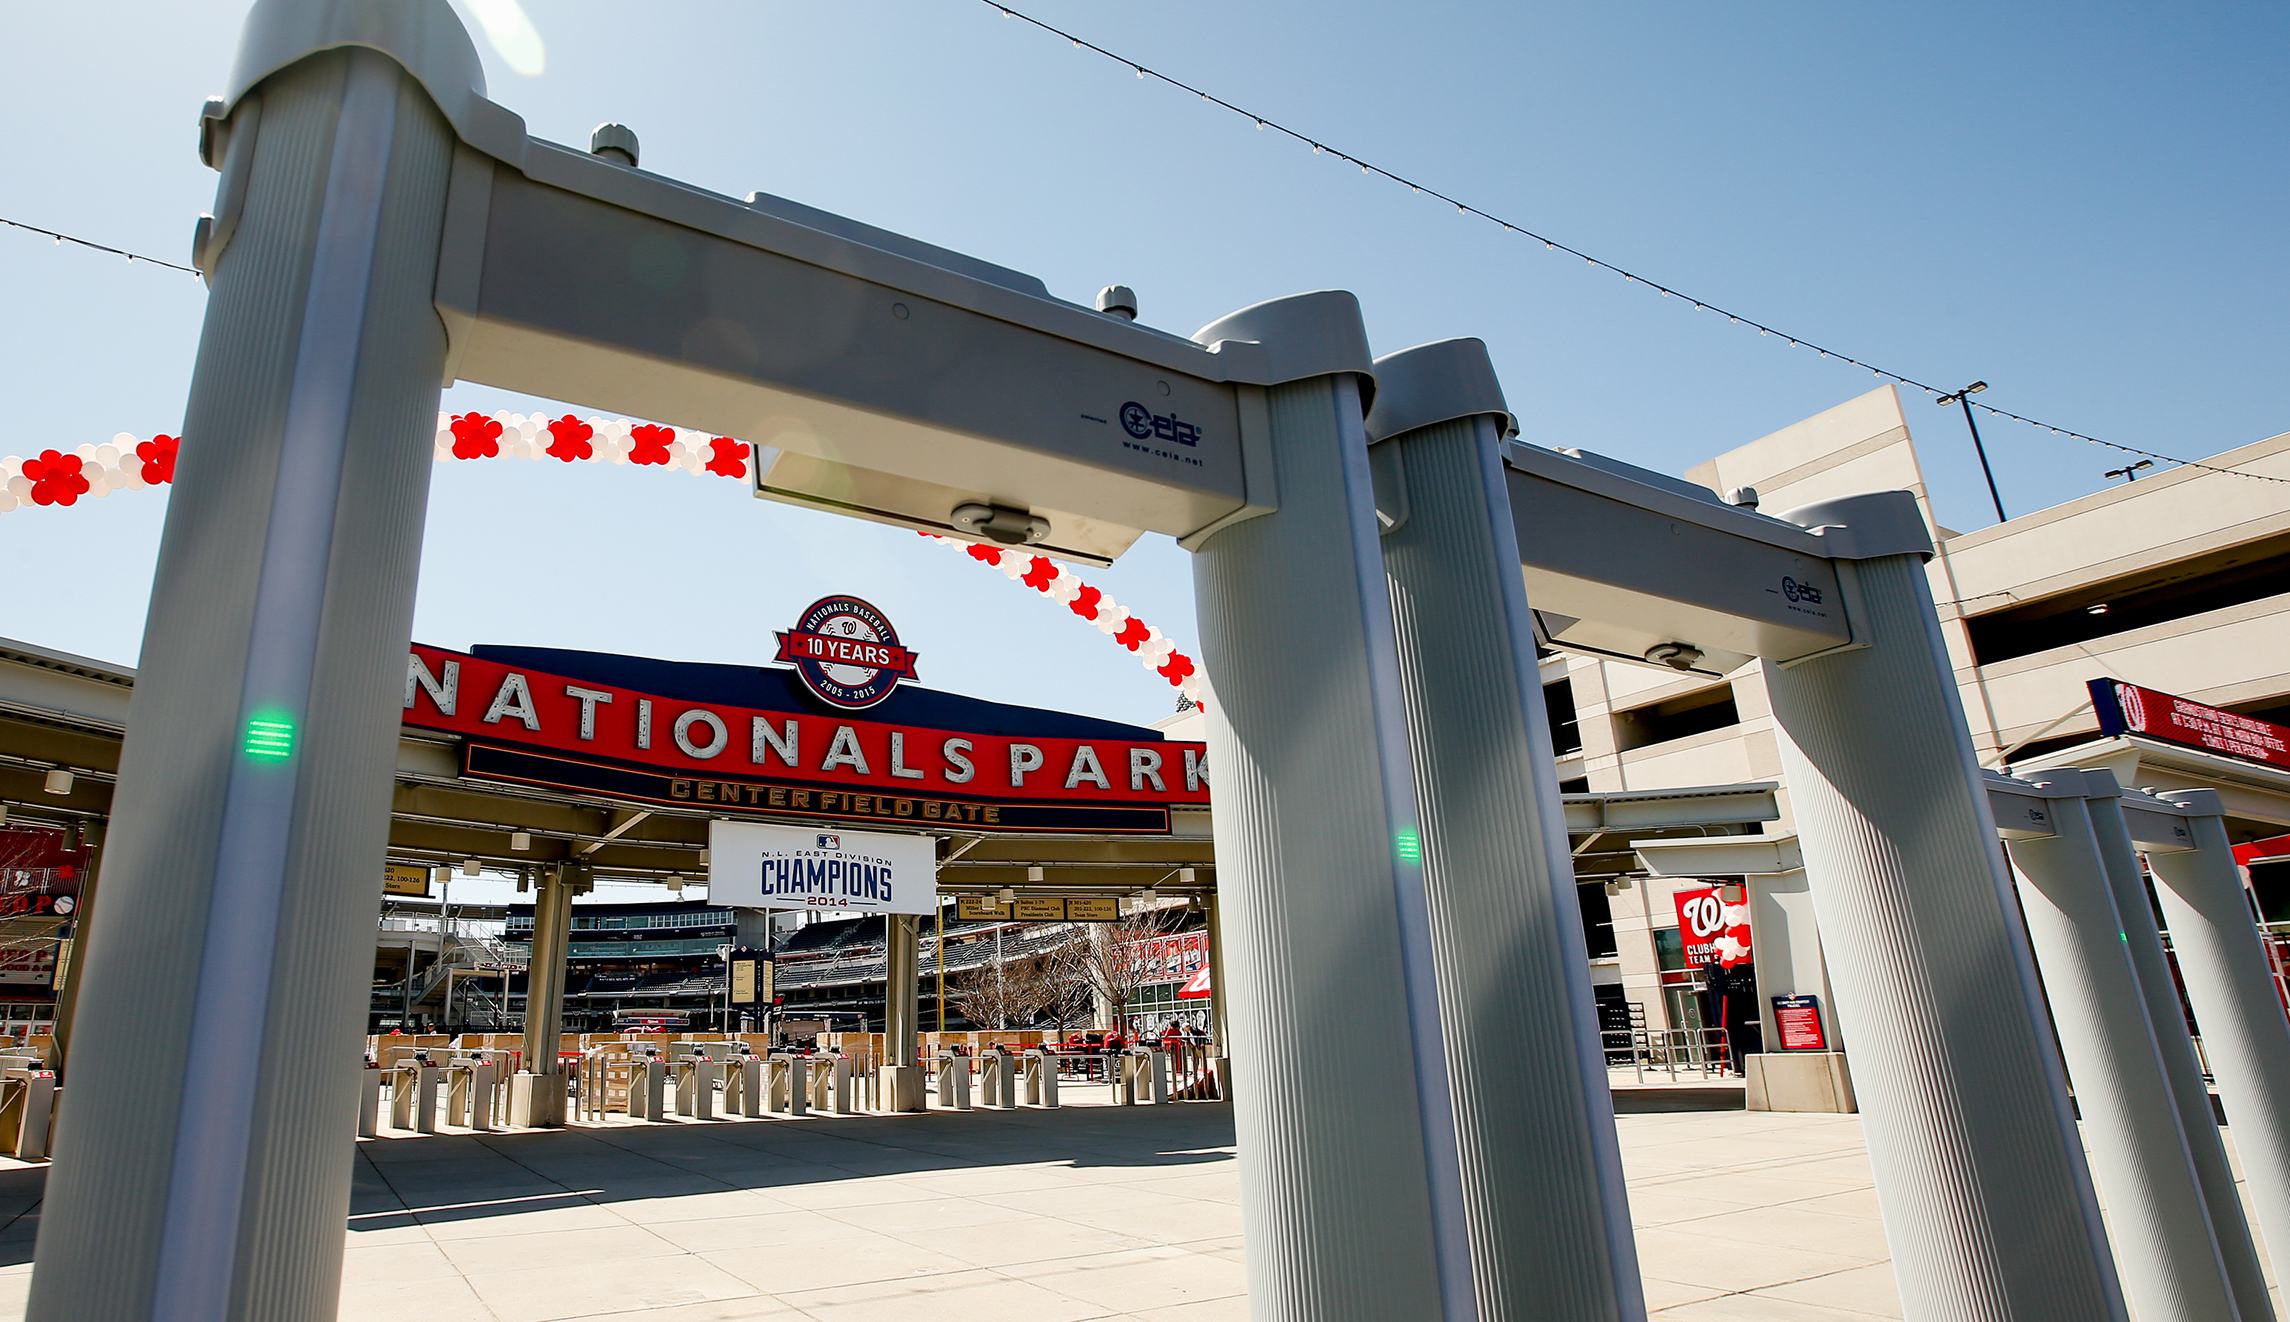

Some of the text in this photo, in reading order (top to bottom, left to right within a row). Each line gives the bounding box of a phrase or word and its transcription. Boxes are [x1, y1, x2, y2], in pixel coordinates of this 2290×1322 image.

[1122, 441, 1203, 466] www.ceia.net
[806, 603, 890, 642] NATIONALS BASEBALL
[807, 637, 890, 665] 10 YEARS
[820, 680, 843, 697] 2005
[853, 686, 876, 699] 2015
[403, 653, 1211, 792] NATIONALS PARK
[670, 778, 1000, 824] CENTER FIELD GATE
[762, 850, 788, 858] N.L.
[835, 852, 893, 867] DIVISION
[761, 858, 892, 902] CHAMPIONS
[807, 896, 848, 907] 2014
[1686, 943, 1716, 955] CLUBH
[1688, 954, 1711, 964] TEAM
